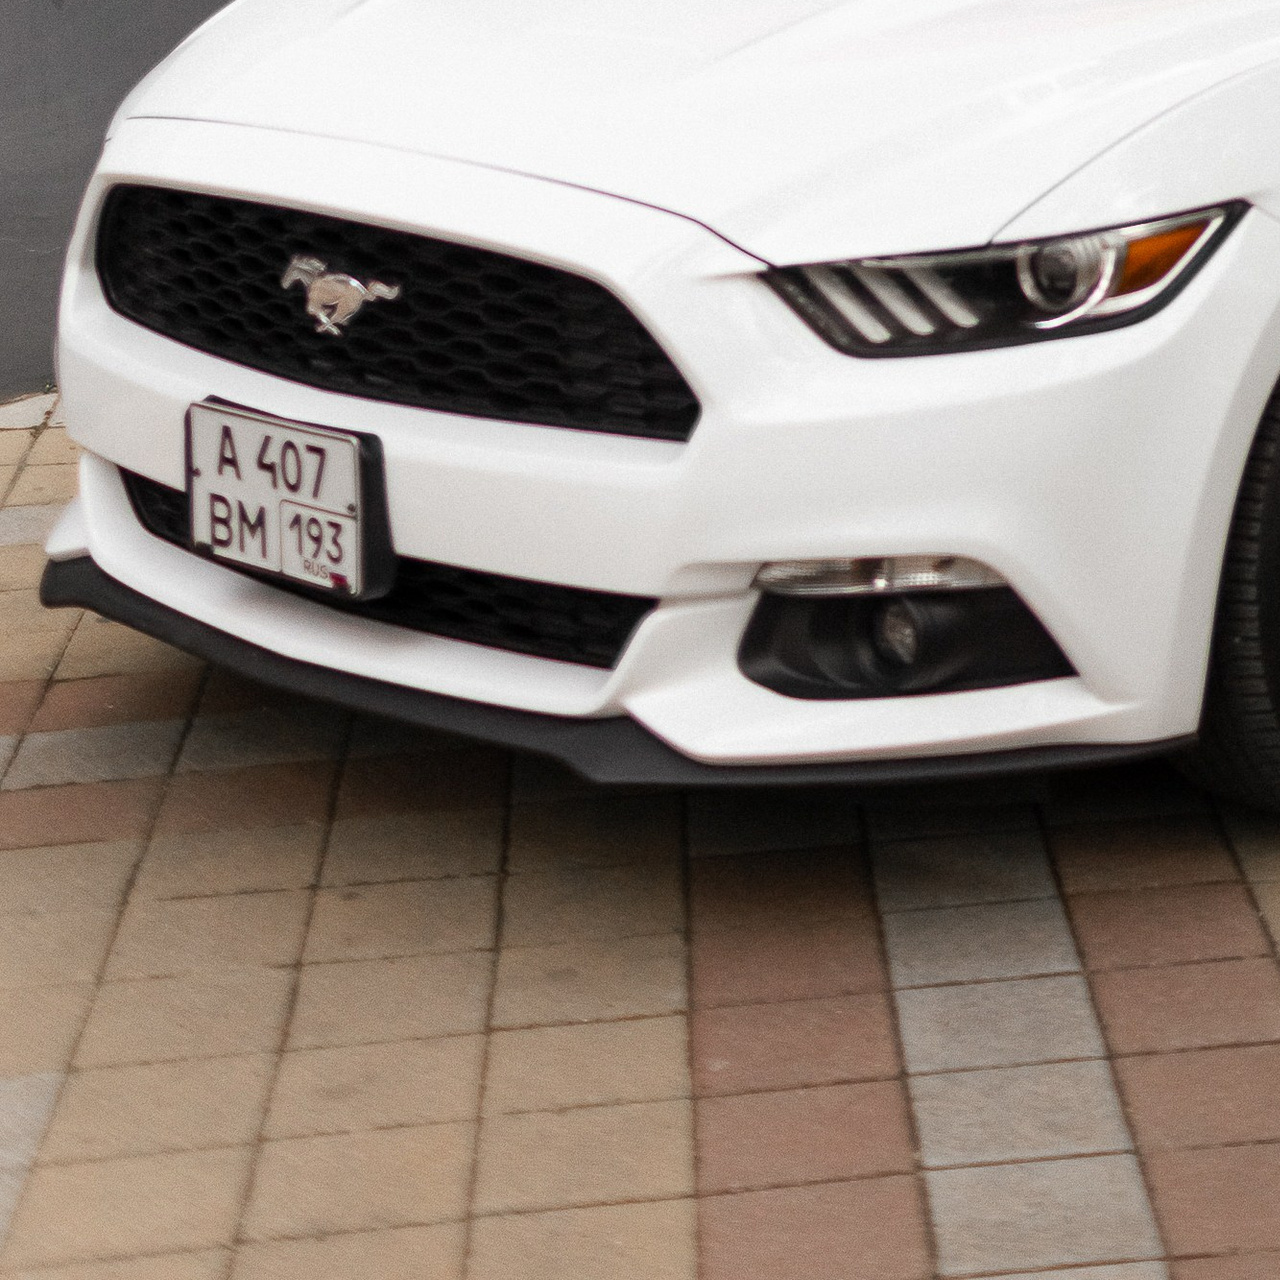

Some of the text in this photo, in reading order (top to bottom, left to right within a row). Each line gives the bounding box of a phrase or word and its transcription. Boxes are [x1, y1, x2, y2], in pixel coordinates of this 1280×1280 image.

[257, 435, 326, 499] 407
[289, 513, 343, 564] 193
[303, 559, 330, 580] RUS
